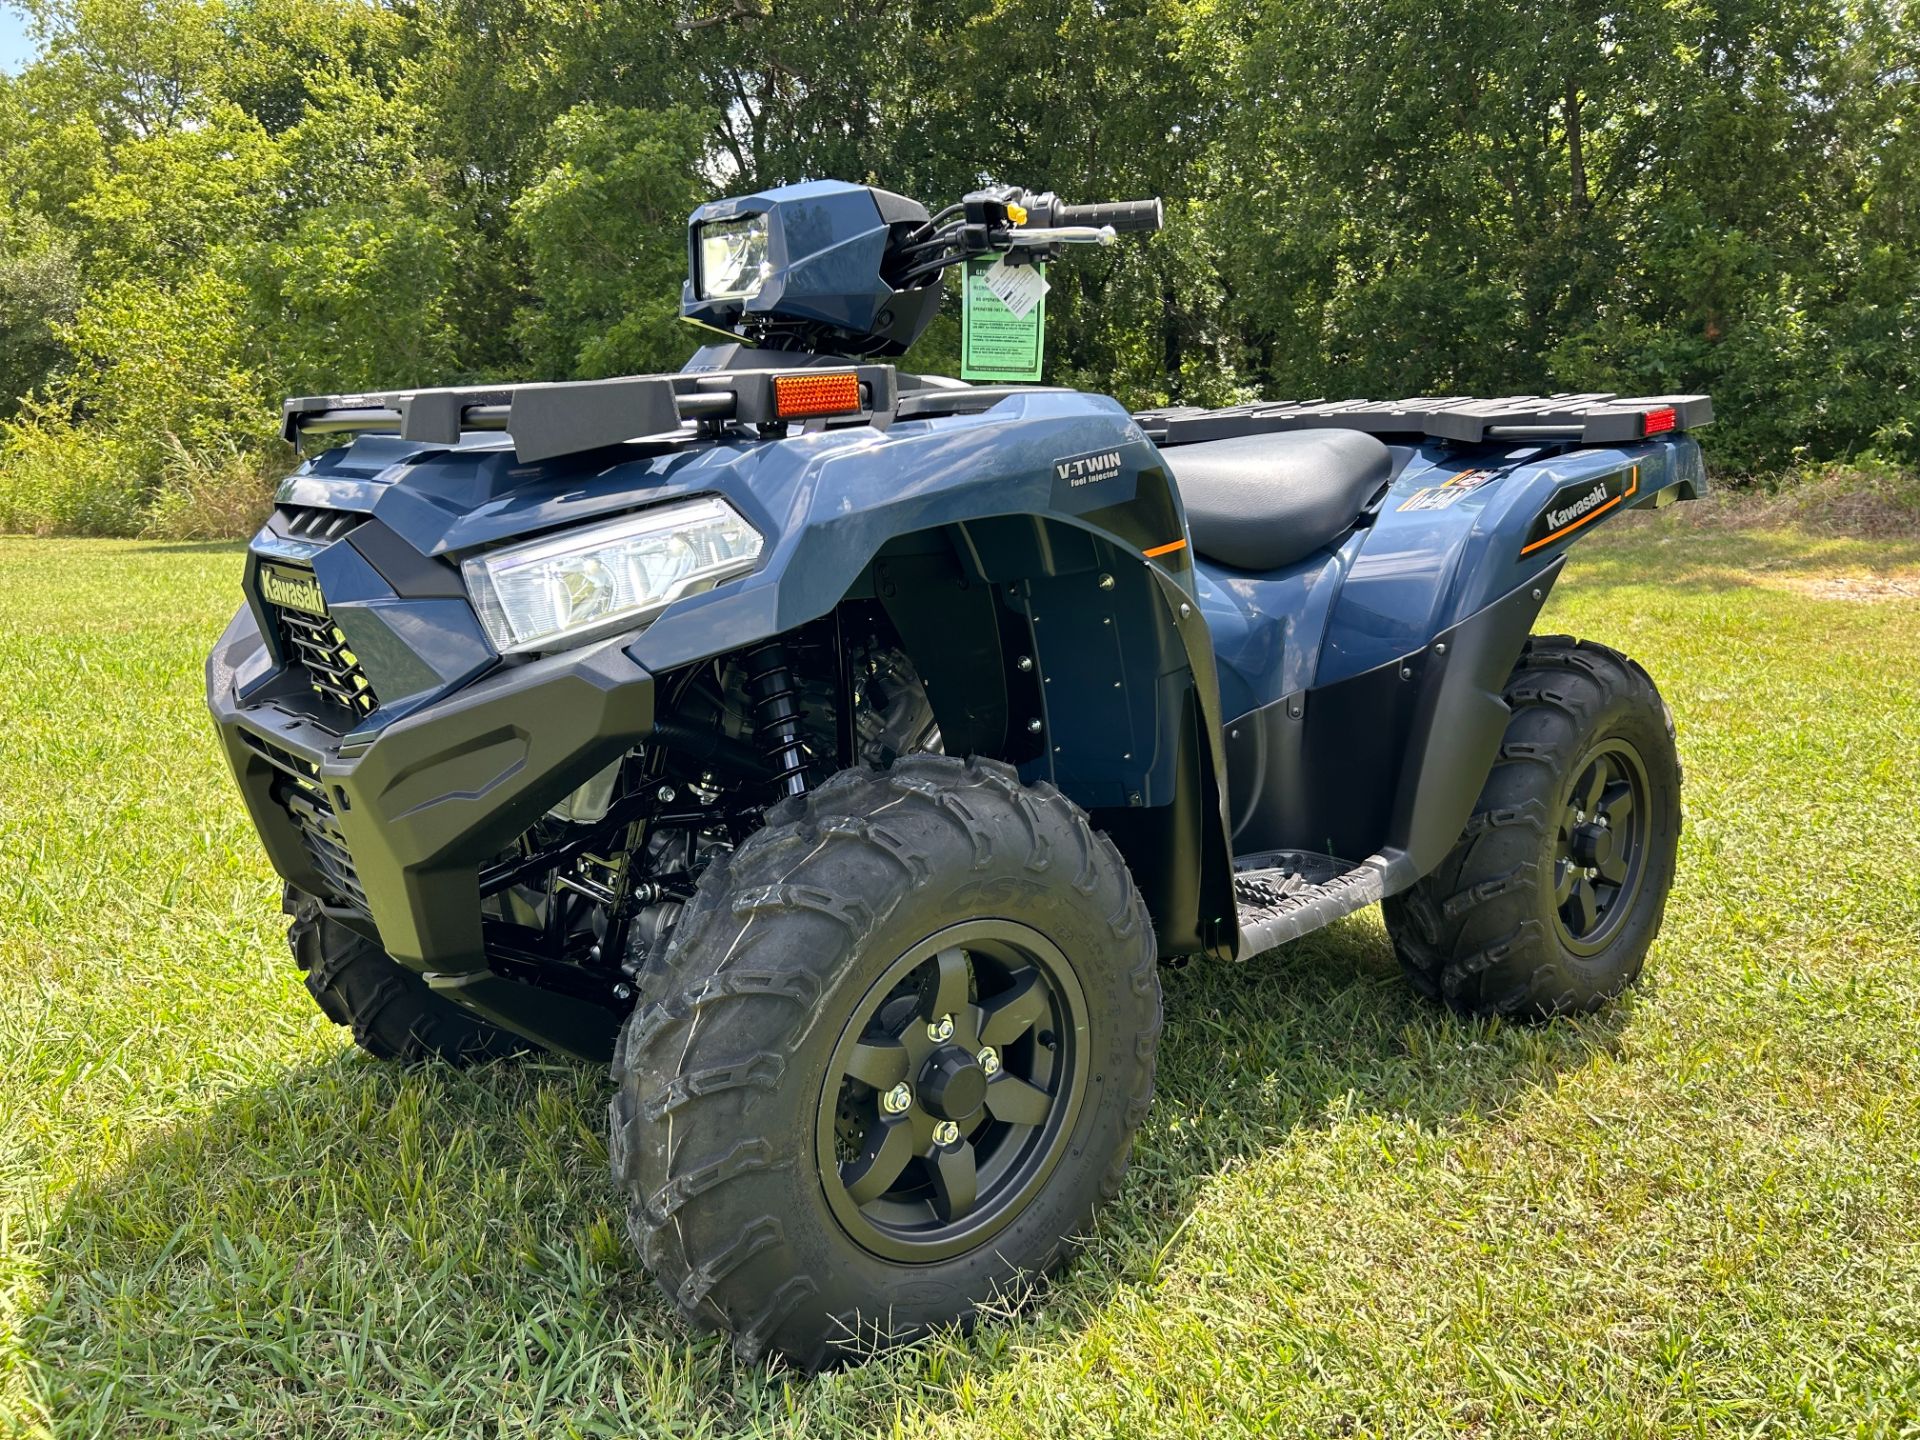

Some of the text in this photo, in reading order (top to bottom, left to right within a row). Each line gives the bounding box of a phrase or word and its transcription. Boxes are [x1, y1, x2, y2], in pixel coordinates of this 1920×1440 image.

[1056, 451, 1122, 480] V-TWIN
[1070, 476, 1087, 487] Fuel
[1546, 482, 1608, 531] Kawasaki
[261, 569, 324, 614] Kawasaki
[940, 876, 1051, 913] CST
